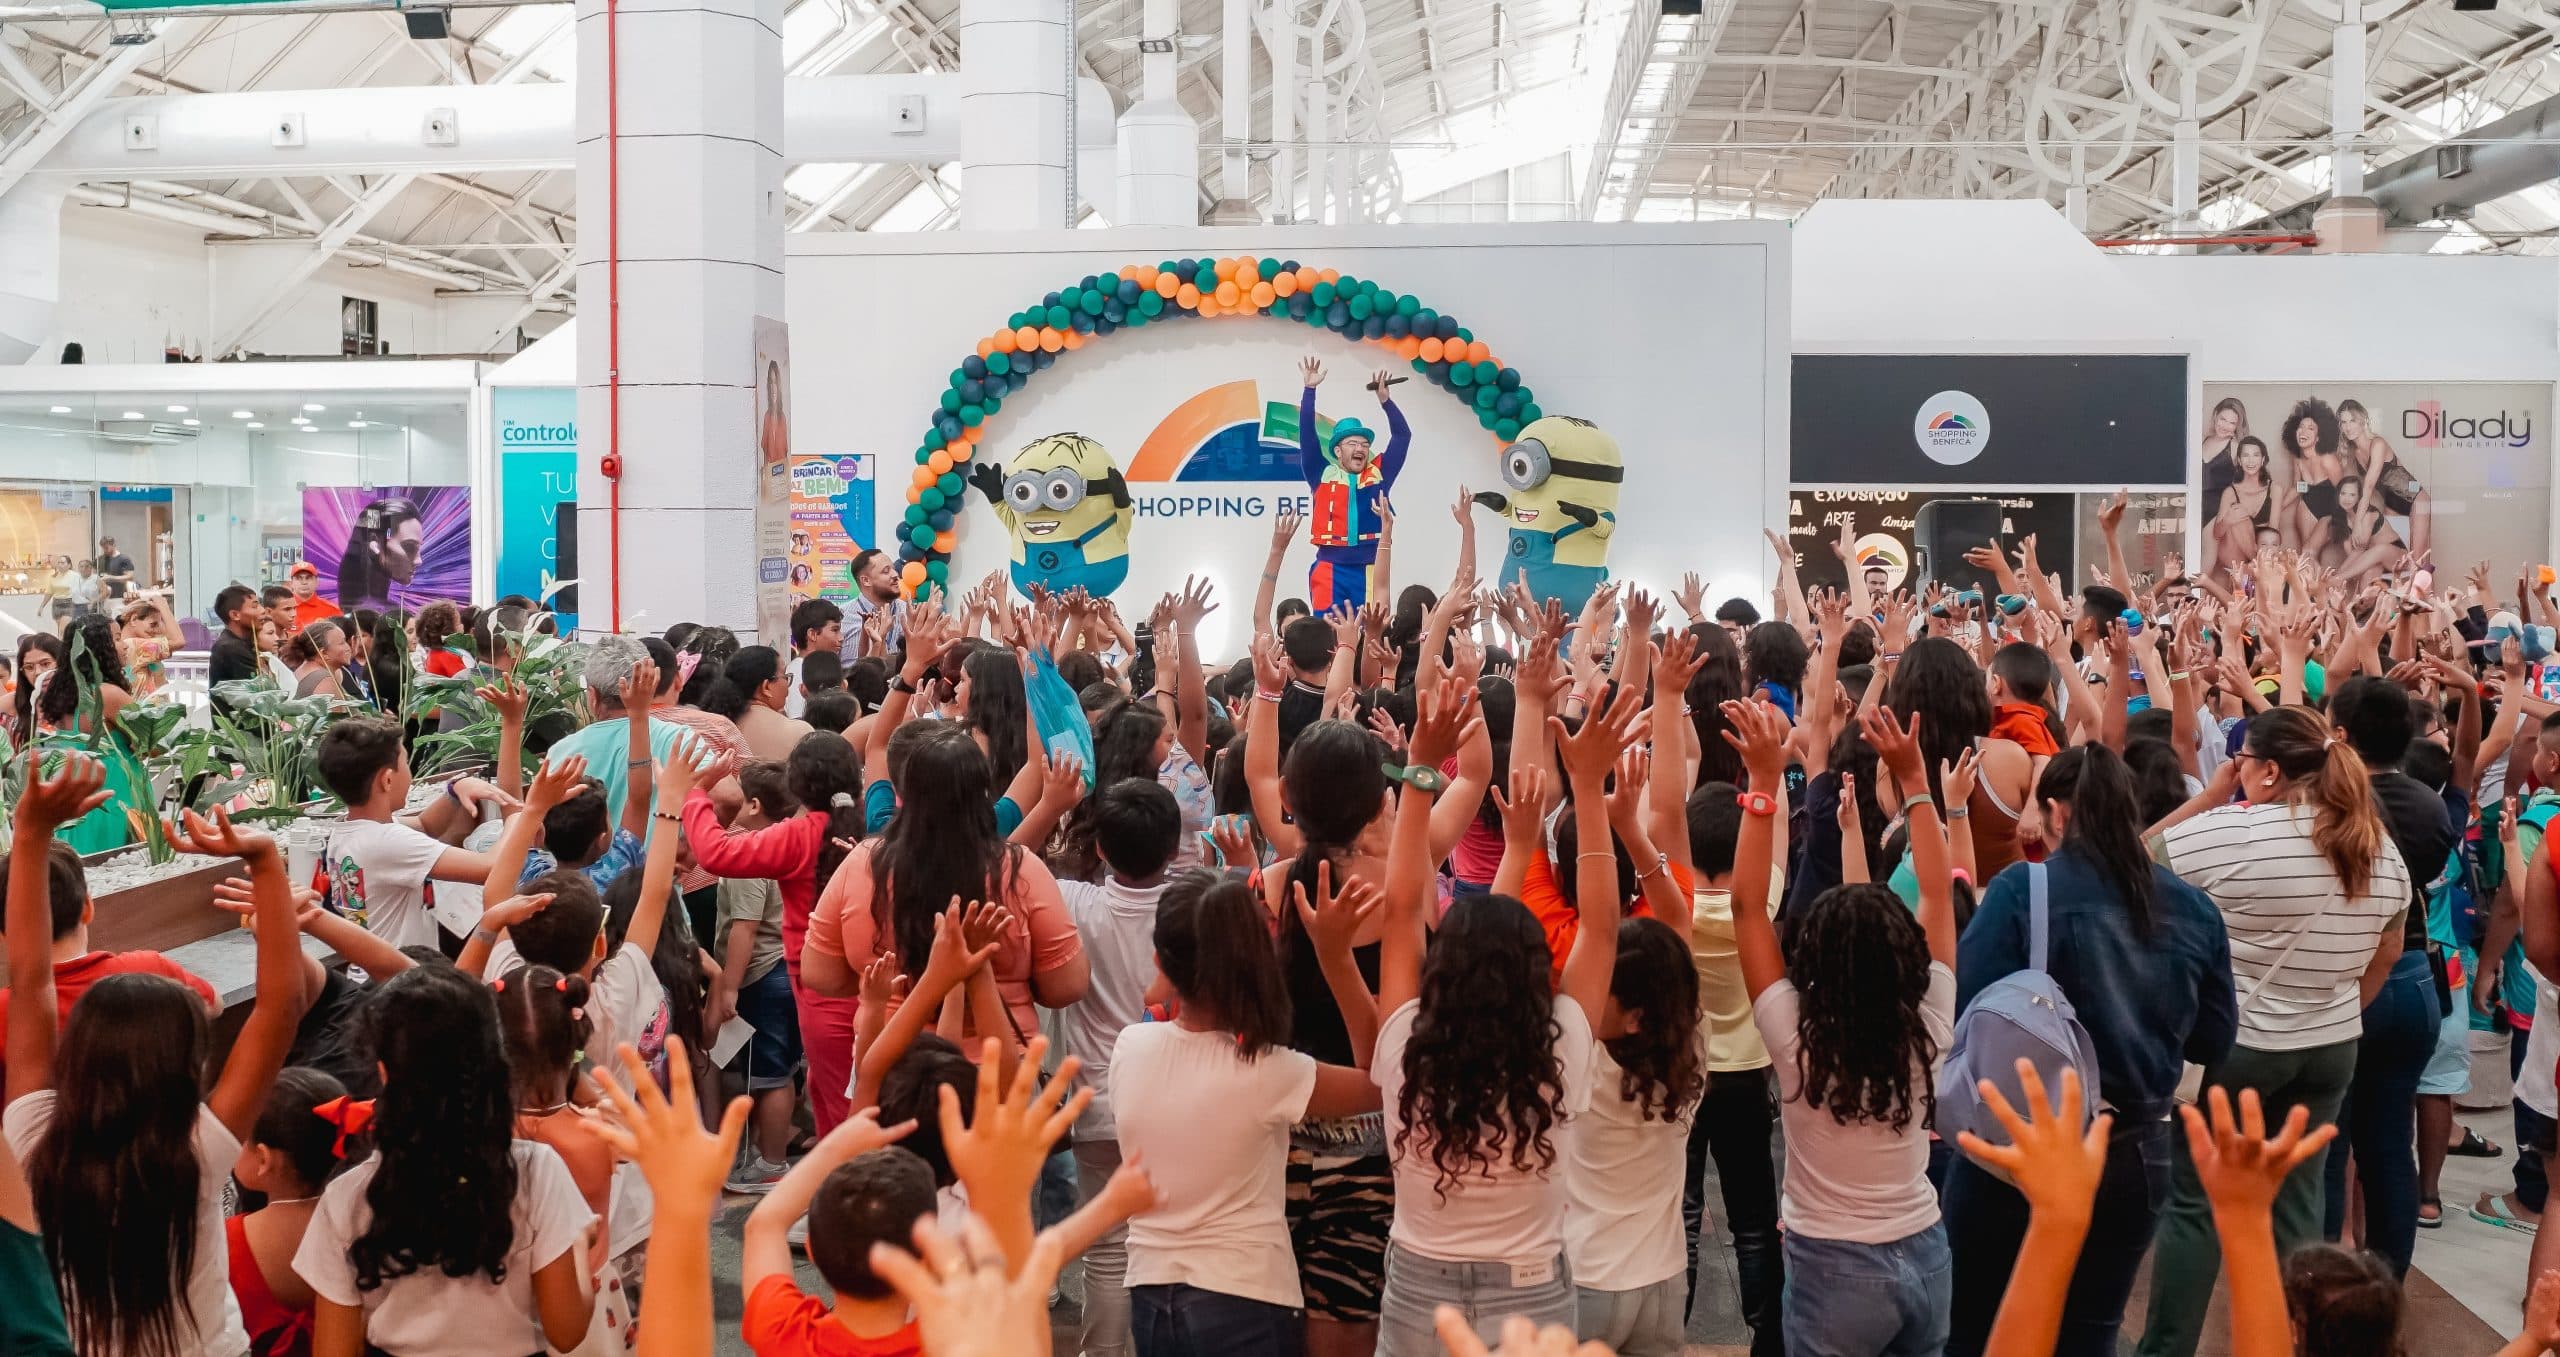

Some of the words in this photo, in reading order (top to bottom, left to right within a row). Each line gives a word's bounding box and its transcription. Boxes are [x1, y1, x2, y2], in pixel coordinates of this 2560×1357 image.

[503, 422, 577, 441] control
[1928, 430, 1977, 438] SHOPPING
[2402, 410, 2531, 447] Dilady
[2441, 440, 2506, 449] LINGERIE
[541, 471, 577, 494] TU
[1823, 511, 1856, 527] ARTE
[1881, 516, 1916, 530] Amiza
[1789, 522, 1818, 536] mento
